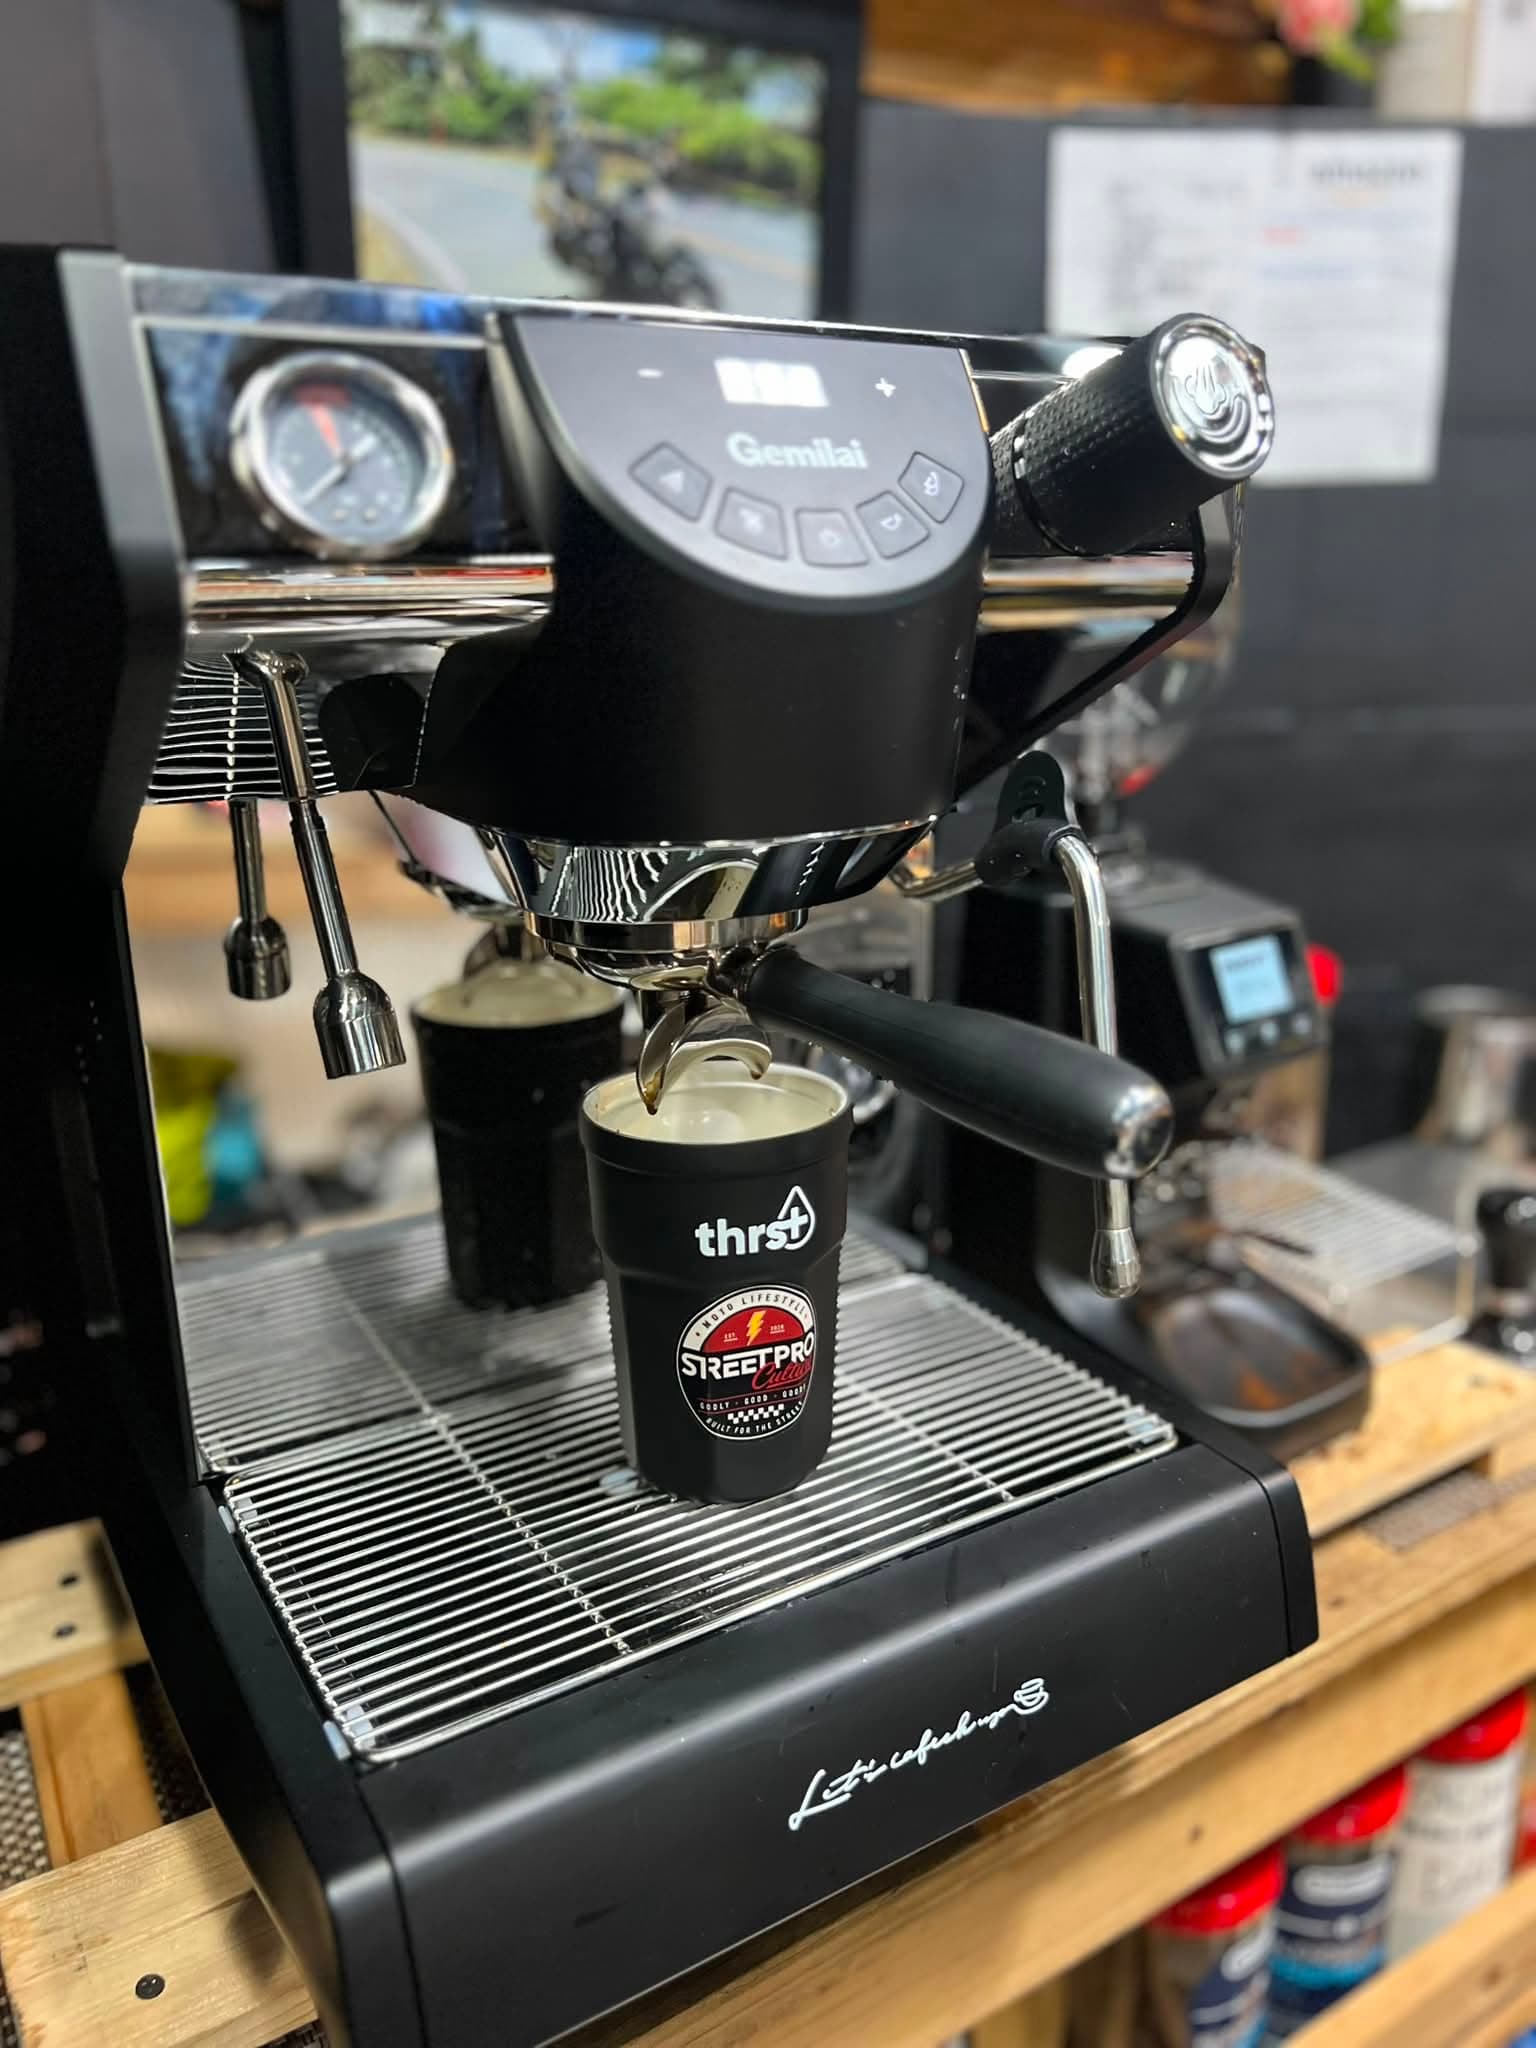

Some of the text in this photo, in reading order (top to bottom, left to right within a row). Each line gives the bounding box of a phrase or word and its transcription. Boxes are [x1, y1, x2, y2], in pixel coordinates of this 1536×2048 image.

[726, 432, 869, 469] Gemilai
[702, 1303, 734, 1329] MOTO
[734, 1426, 751, 1435] FOR
[755, 1421, 772, 1433] THE
